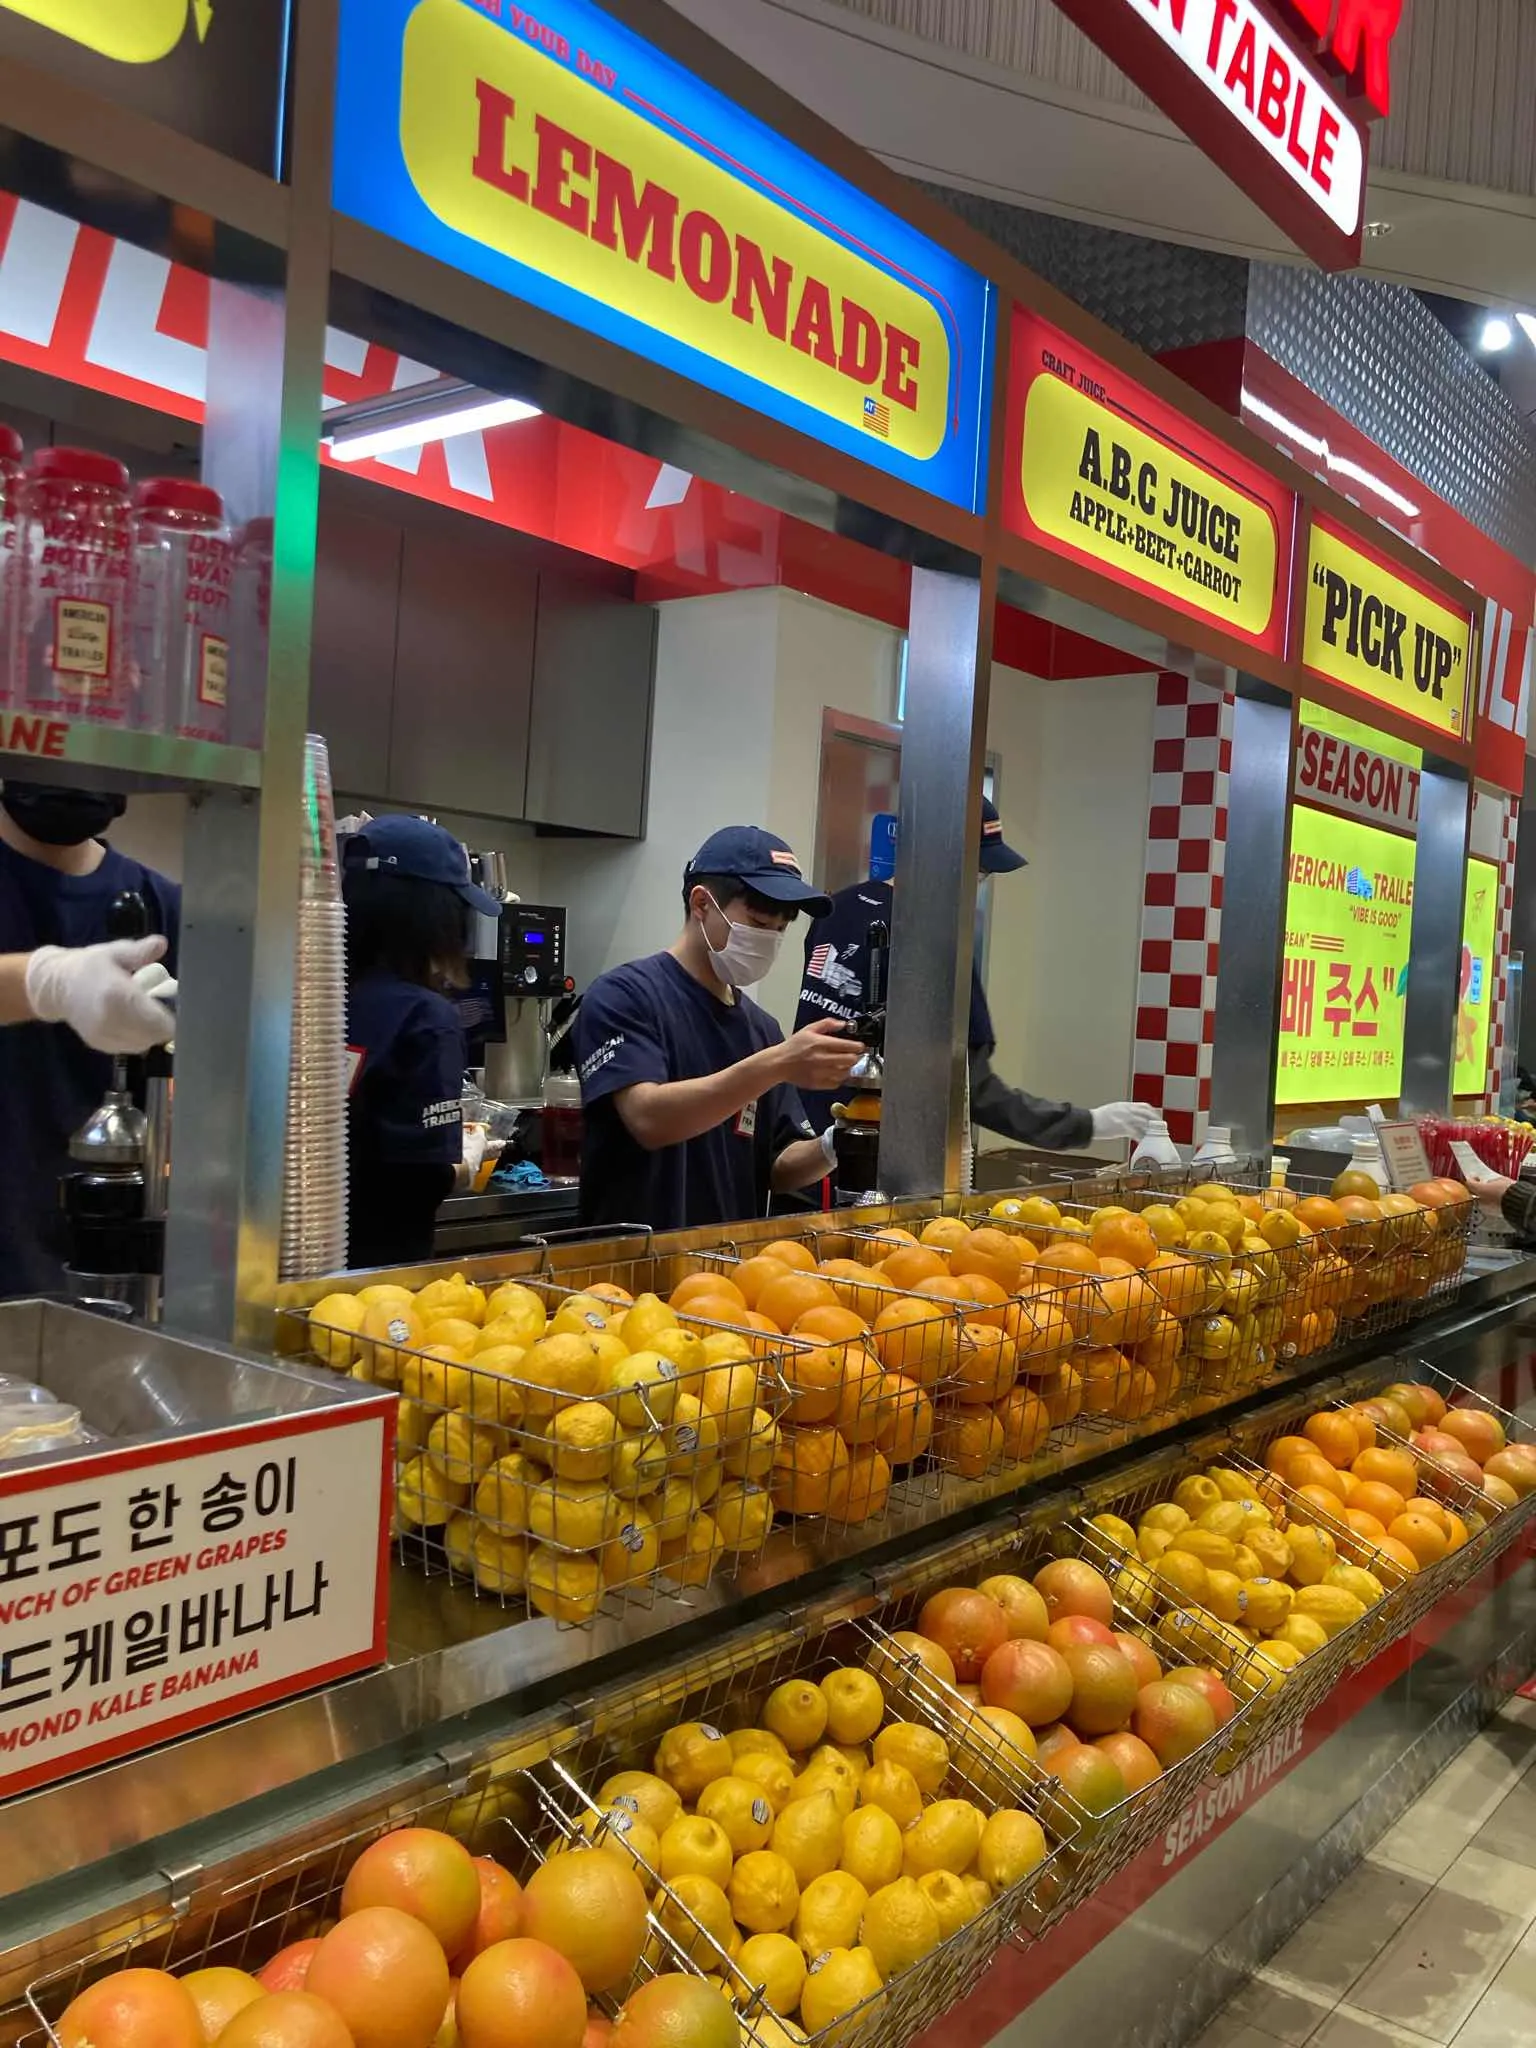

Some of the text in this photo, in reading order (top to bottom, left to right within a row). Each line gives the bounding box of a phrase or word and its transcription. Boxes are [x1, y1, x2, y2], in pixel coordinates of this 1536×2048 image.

[510, 4, 569, 62] YOUR
[576, 48, 617, 90] DAY
[1206, 0, 1340, 195] TABLE
[472, 78, 920, 412] LEMONADE
[1042, 350, 1107, 404] CRAFT JUICE
[1069, 491, 1242, 604] APPLE+BEET+CARROT
[1078, 428, 1242, 564] A.B.C JUICE
[1313, 563, 1462, 701] "PICK UP"
[1370, 910, 1377, 925] IS
[1373, 873, 1413, 906] TRAILE
[581, 1033, 625, 1073] AMERICAN
[0, 1456, 297, 1583] 포도 한 송이
[0, 1528, 288, 1626] NCH OF GREEN GRAPES
[0, 1560, 329, 1712] 드케일바나나
[0, 1648, 259, 1754] MOND KALE BANANA
[1162, 1718, 1303, 1867] SEASON TABLE
